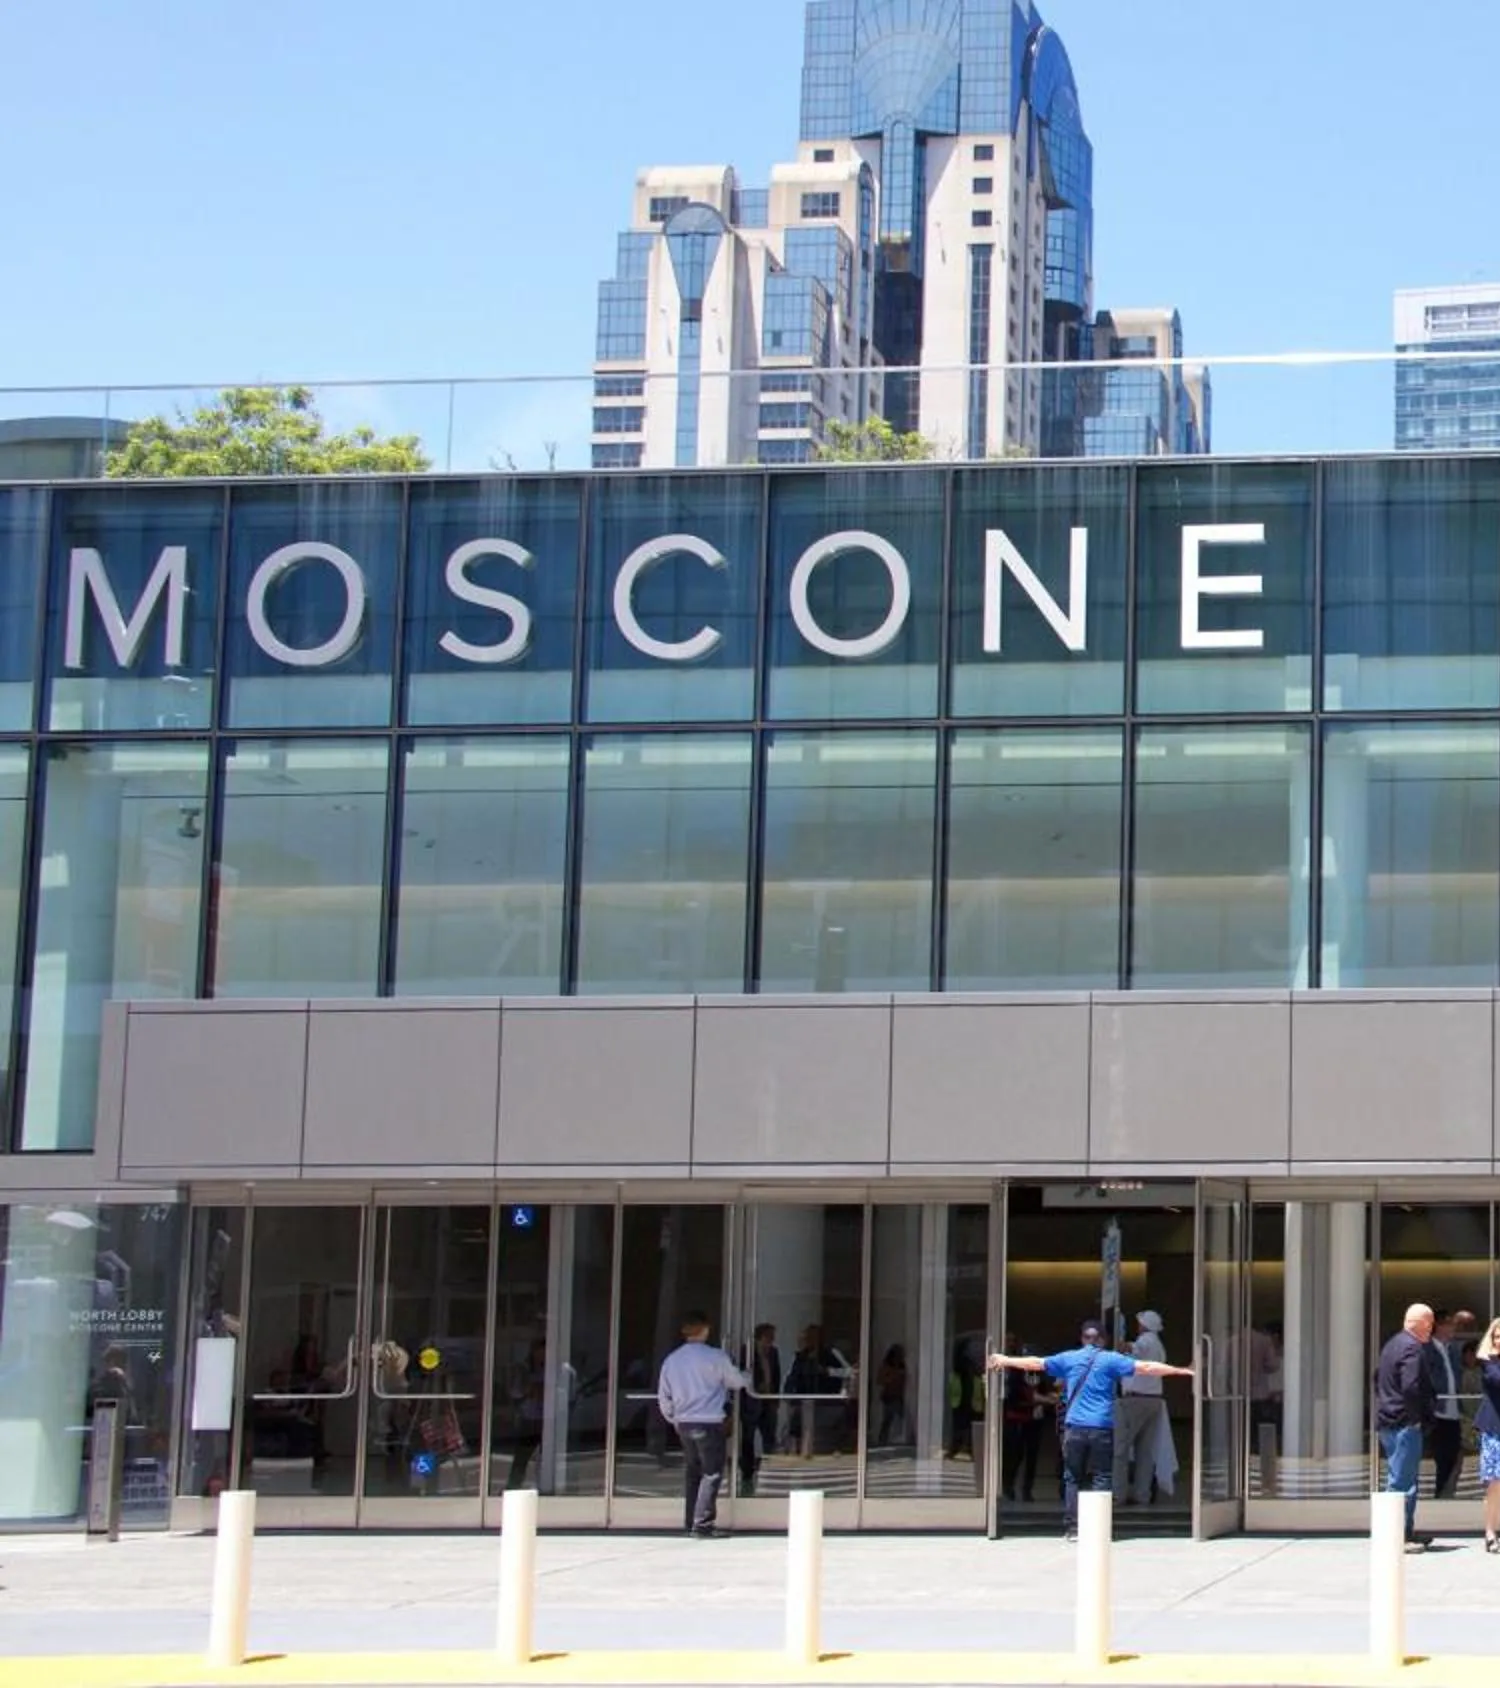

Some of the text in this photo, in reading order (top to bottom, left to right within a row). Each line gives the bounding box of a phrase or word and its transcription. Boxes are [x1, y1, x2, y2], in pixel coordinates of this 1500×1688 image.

[63, 521, 1267, 671] MOSCONE
[139, 1205, 171, 1222] 747
[69, 1308, 164, 1321] NORTH LOBBY
